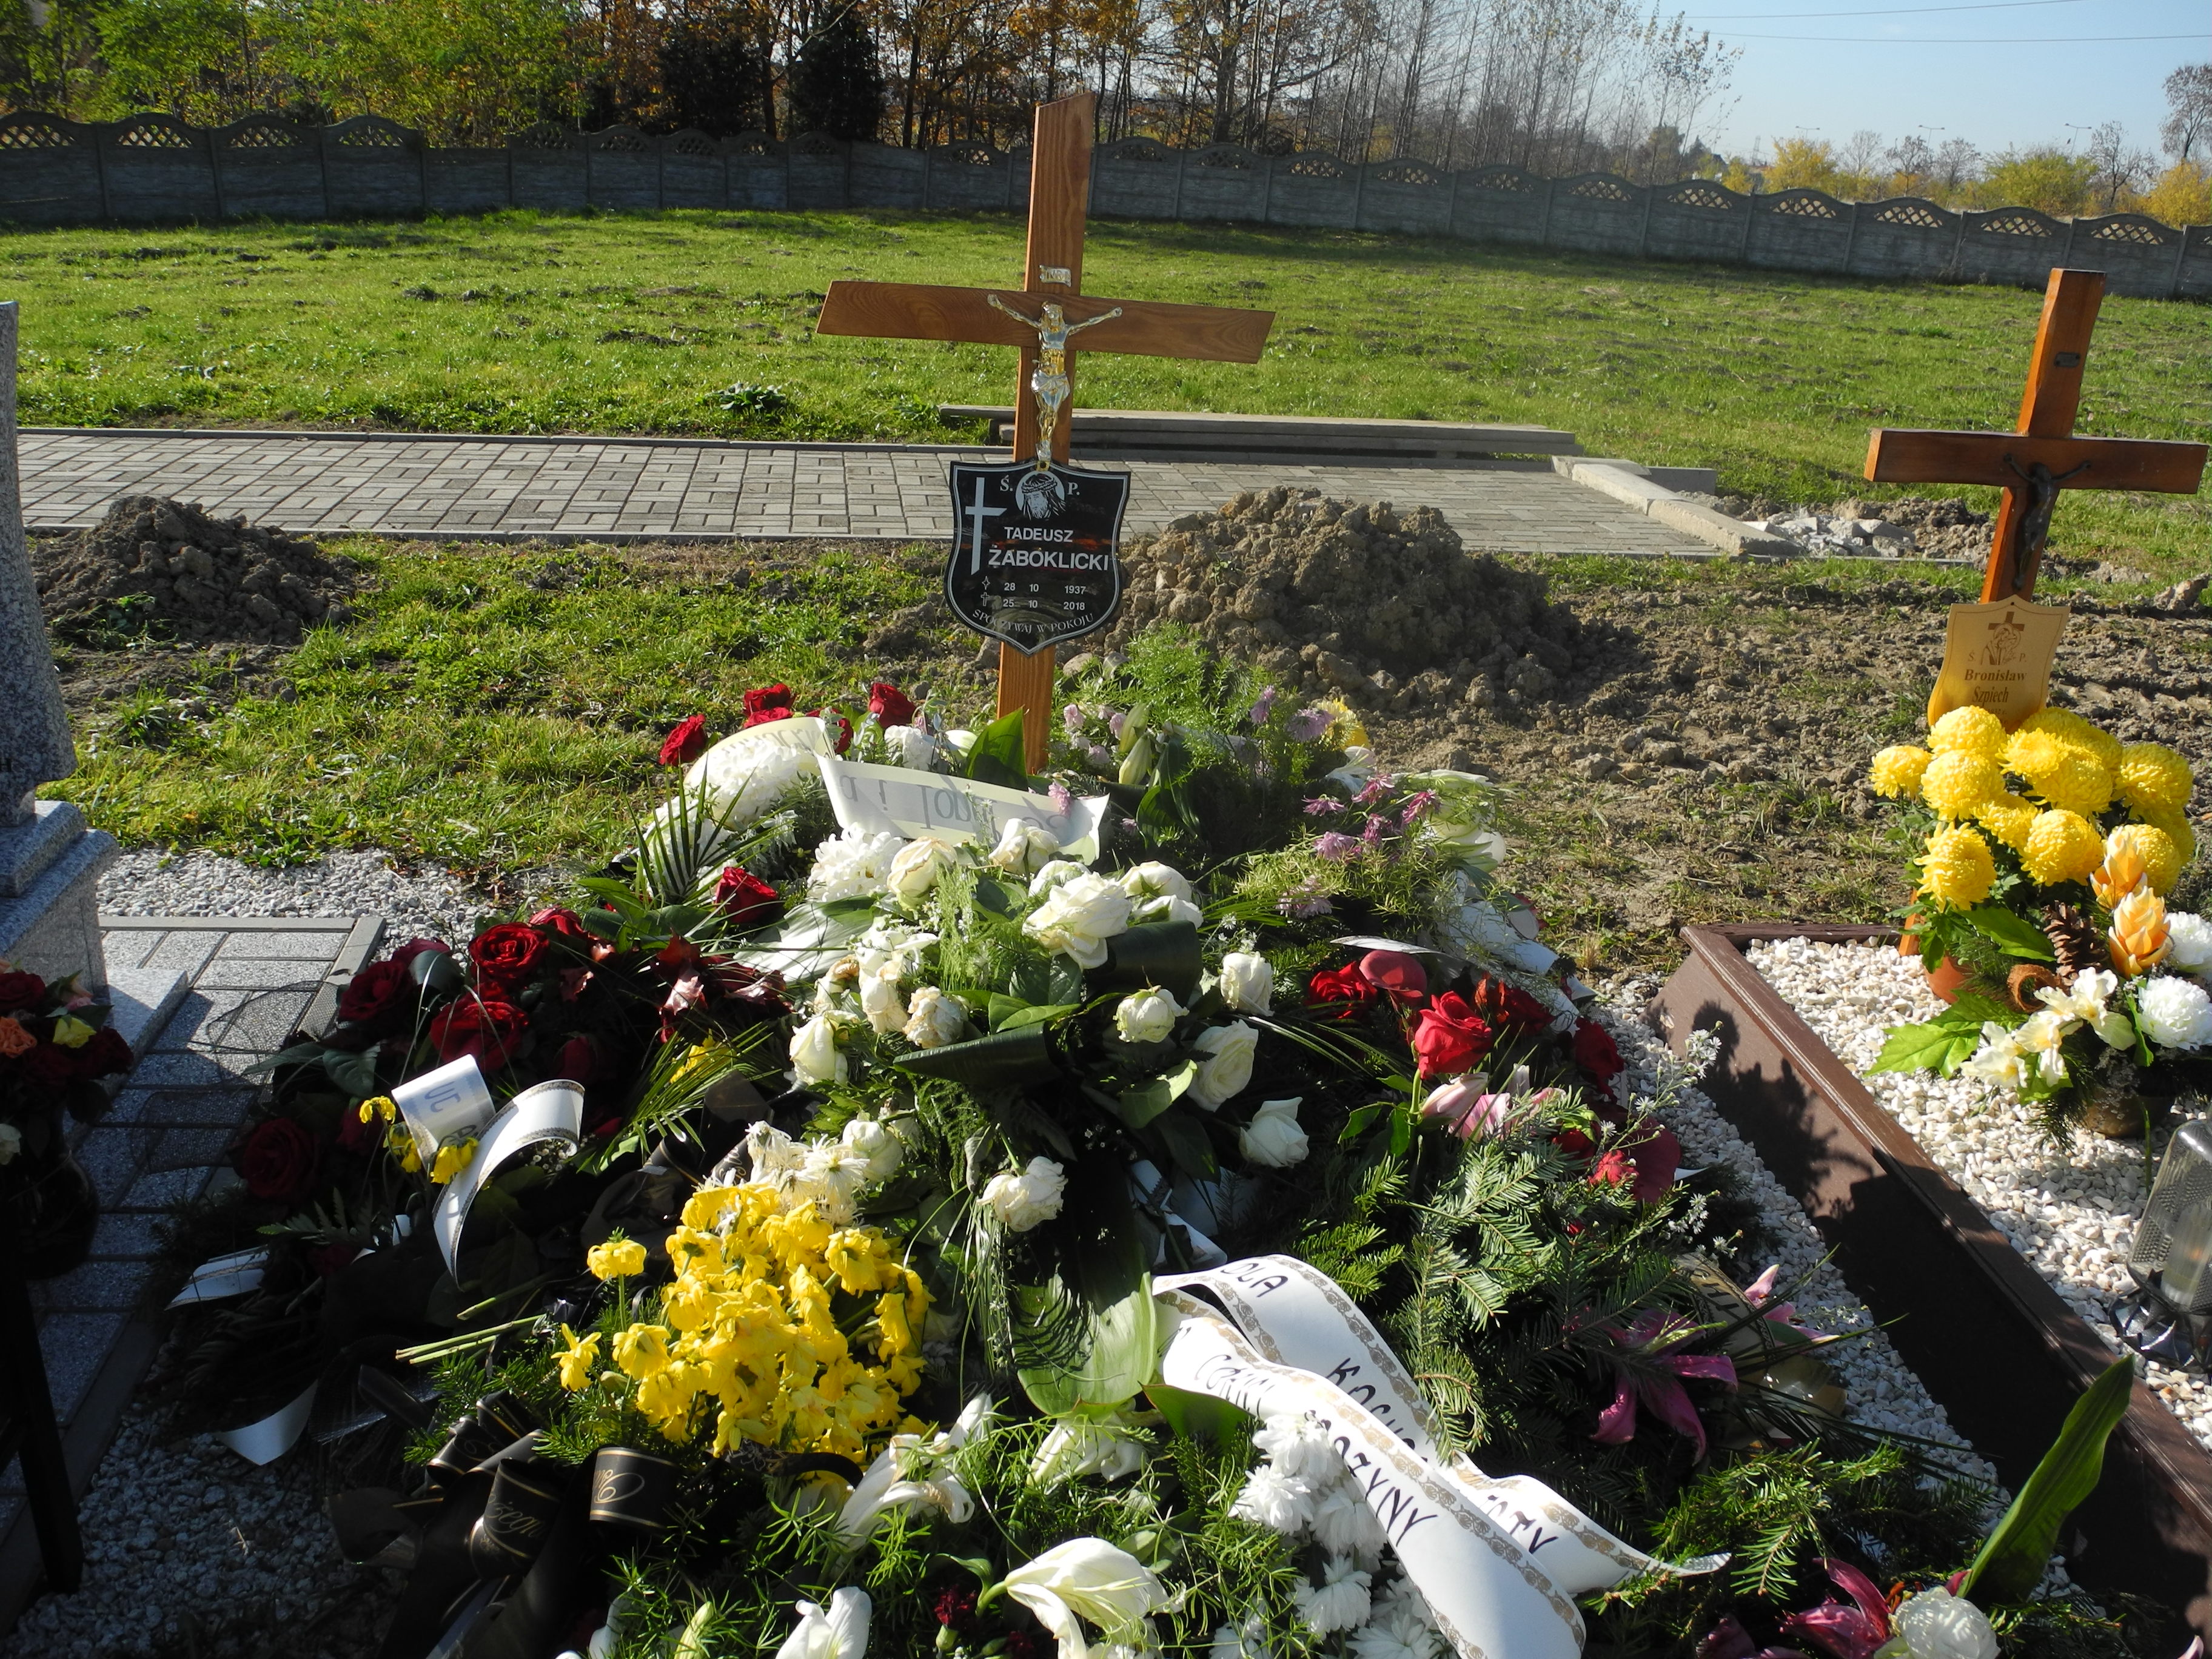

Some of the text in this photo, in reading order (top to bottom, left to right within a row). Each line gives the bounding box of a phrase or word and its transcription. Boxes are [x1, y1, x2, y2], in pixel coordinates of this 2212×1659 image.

[1000, 475, 1080, 495] Ś. P.
[1004, 526, 1074, 543] TADEUSZ
[1004, 583, 1086, 595] 28 10 1937
[1003, 599, 1085, 611] 25 10 2018
[973, 609, 1094, 634] SPOCZYWAJ W POKOJU
[1965, 669, 2027, 681] Bronisław
[1972, 685, 2009, 707] Szpiech
[1221, 1263, 1289, 1298] DLA
